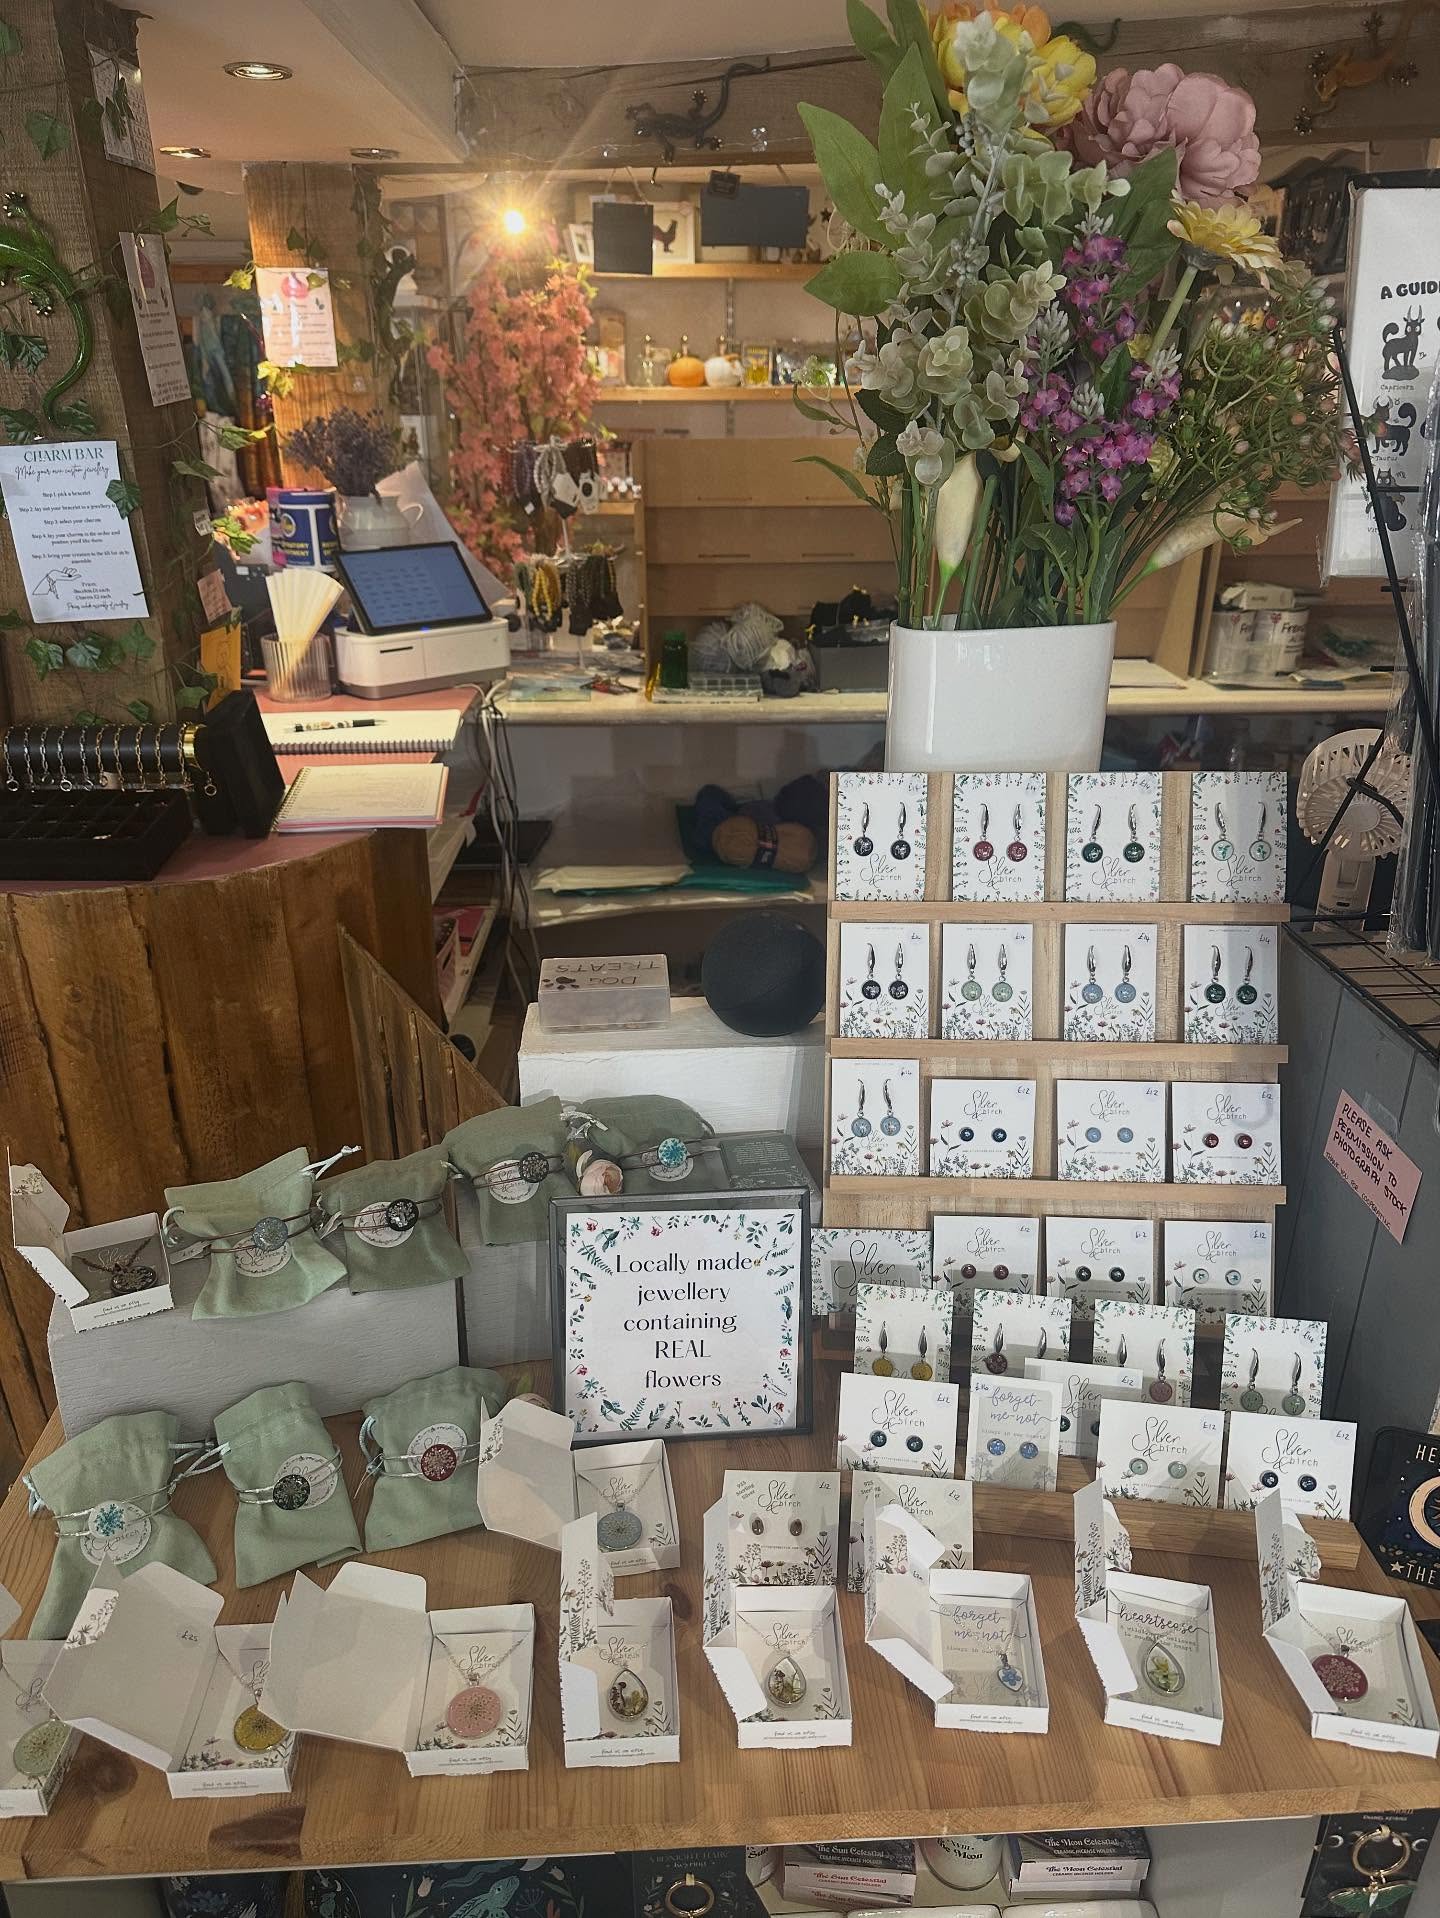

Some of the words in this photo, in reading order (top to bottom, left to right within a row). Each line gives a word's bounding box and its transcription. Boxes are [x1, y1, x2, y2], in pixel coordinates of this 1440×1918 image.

[1380, 286, 1392, 300] A
[1396, 280, 1440, 297] GUID
[1380, 384, 1414, 392] Capricorn
[24, 448, 72, 462] CHARM
[75, 447, 104, 460] BAR
[860, 853, 897, 883] Silver
[978, 855, 1015, 885] Silver
[1092, 856, 1131, 886] Silver
[1216, 854, 1256, 884] Silver
[1138, 932, 1150, 943] £14
[1259, 933, 1270, 944] £14
[556, 961, 660, 973] TREATS
[589, 976, 637, 985] DOG
[1145, 1087, 1159, 1096] £12
[964, 1089, 998, 1116] Silver
[1090, 1089, 1124, 1116] Silver
[1207, 1093, 1242, 1120] Silver
[1342, 1102, 1373, 1138] PLEASE
[1376, 1139, 1393, 1161] ASK
[1326, 1151, 1339, 1172] THANK
[1337, 1117, 1385, 1172] PERMISSION
[1388, 1171, 1398, 1188] TO
[1333, 1132, 1381, 1186] PHOTOGRAPH
[1384, 1186, 1408, 1217] STOCK
[966, 1227, 1000, 1252] Silver
[1080, 1227, 1115, 1254] Silver
[1197, 1230, 1232, 1257] Silver
[1254, 1230, 1267, 1239] £12
[616, 1252, 690, 1274] Locally
[697, 1252, 752, 1270] made
[834, 1240, 896, 1290] Silver
[637, 1282, 730, 1306] jewellery
[1050, 1308, 1064, 1316] £14
[623, 1312, 738, 1334] containing
[655, 1340, 711, 1359] REAL
[645, 1370, 722, 1388] flowers
[1121, 1376, 1134, 1386] £12
[990, 1388, 1037, 1412] forget
[1061, 1375, 1102, 1408] Silver
[872, 1390, 918, 1424] Silver
[1080, 1401, 1100, 1410] bir
[1131, 1416, 1181, 1452] Silver
[1203, 1421, 1216, 1430] £12
[1336, 1430, 1350, 1440] £12
[1159, 1444, 1188, 1455] birch
[1262, 1429, 1312, 1464] Silver
[1415, 1444, 1440, 1464] HE
[1289, 1456, 1319, 1468] birch
[758, 1480, 796, 1508] Silver
[819, 1482, 831, 1490] £12
[948, 1489, 961, 1501] £12
[910, 1507, 934, 1516] birch
[1406, 1563, 1436, 1585] THE
[953, 1606, 1003, 1630] forget
[1120, 1603, 1196, 1634] heartsease
[181, 1630, 198, 1642] £25
[765, 1622, 799, 1646] Silver
[816, 1843, 830, 1853] The
[833, 1846, 848, 1854] Sun
[850, 1846, 884, 1858] Celestial
[1045, 1837, 1060, 1846] The
[1062, 1837, 1083, 1846] Moon
[1084, 1838, 1119, 1846] Celestial
[748, 1847, 769, 1858] Sun
[953, 1849, 983, 1860] Moon
[830, 1873, 848, 1881] Sun
[850, 1875, 887, 1884] Celestial
